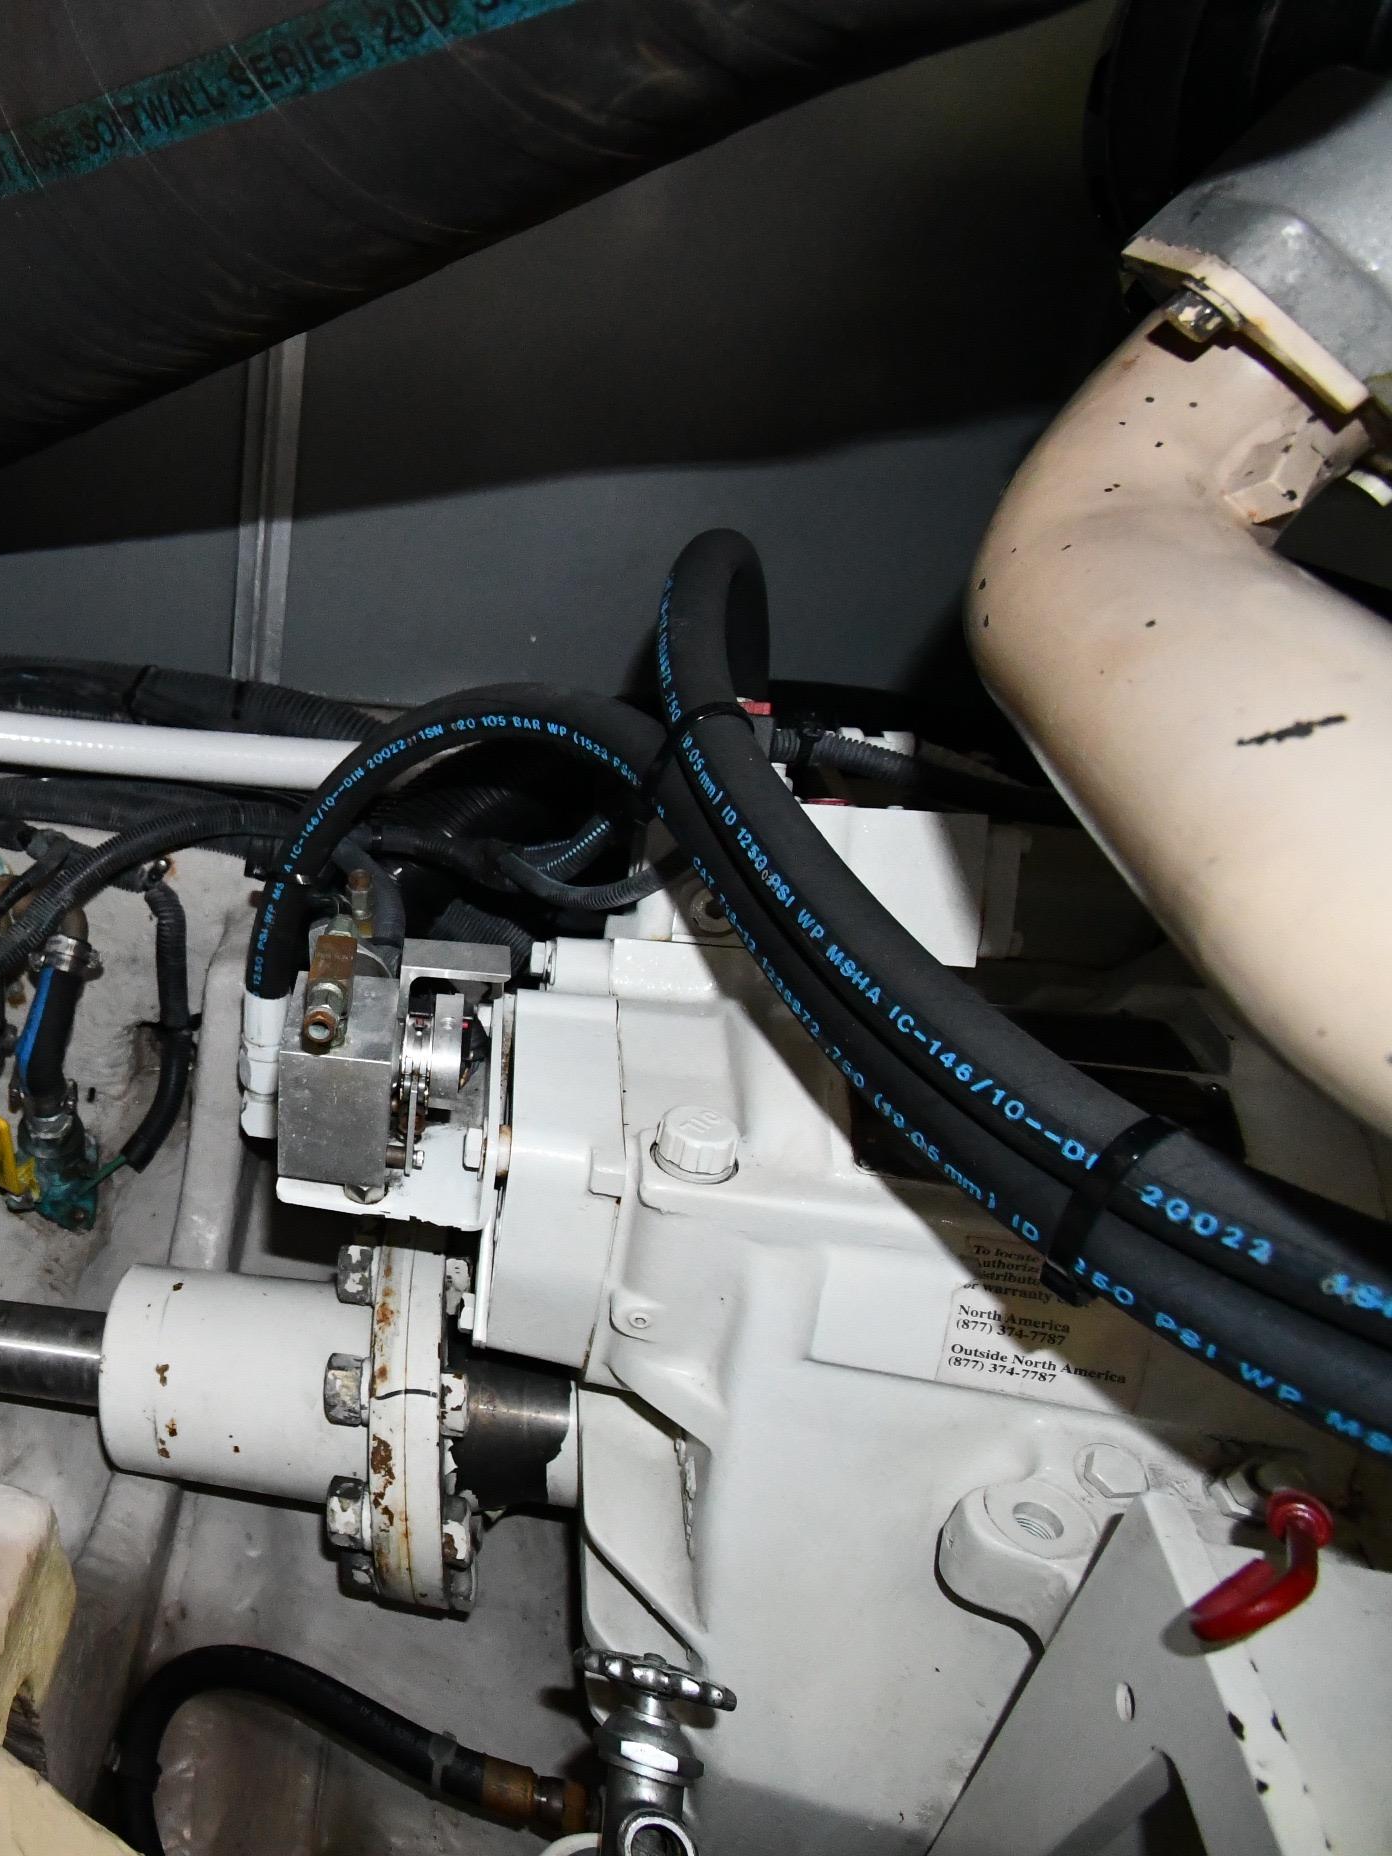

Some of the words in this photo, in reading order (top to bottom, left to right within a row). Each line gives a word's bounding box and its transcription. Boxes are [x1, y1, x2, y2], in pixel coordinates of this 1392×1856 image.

[228, 21, 365, 100] SERIES
[366, 738, 407, 769] 20022
[480, 715, 507, 727] 105
[512, 715, 541, 731] BAR
[547, 721, 567, 737] WP
[798, 908, 825, 939] WP
[826, 944, 881, 1005] MSHA
[974, 1245, 990, 1256] To
[983, 1284, 1052, 1304] warranty
[1011, 1213, 1040, 1242] ID
[1239, 1362, 1303, 1403] WP
[956, 1318, 993, 1334] (877)
[996, 1324, 1066, 1346] 374-7787
[958, 1304, 1002, 1322] North
[1004, 1315, 1070, 1333] America
[948, 1355, 984, 1372] (877)
[988, 1363, 1057, 1384] 374-7787
[951, 1343, 1008, 1363] Outside
[1012, 1354, 1057, 1371] North
[1060, 1363, 1127, 1384] America
